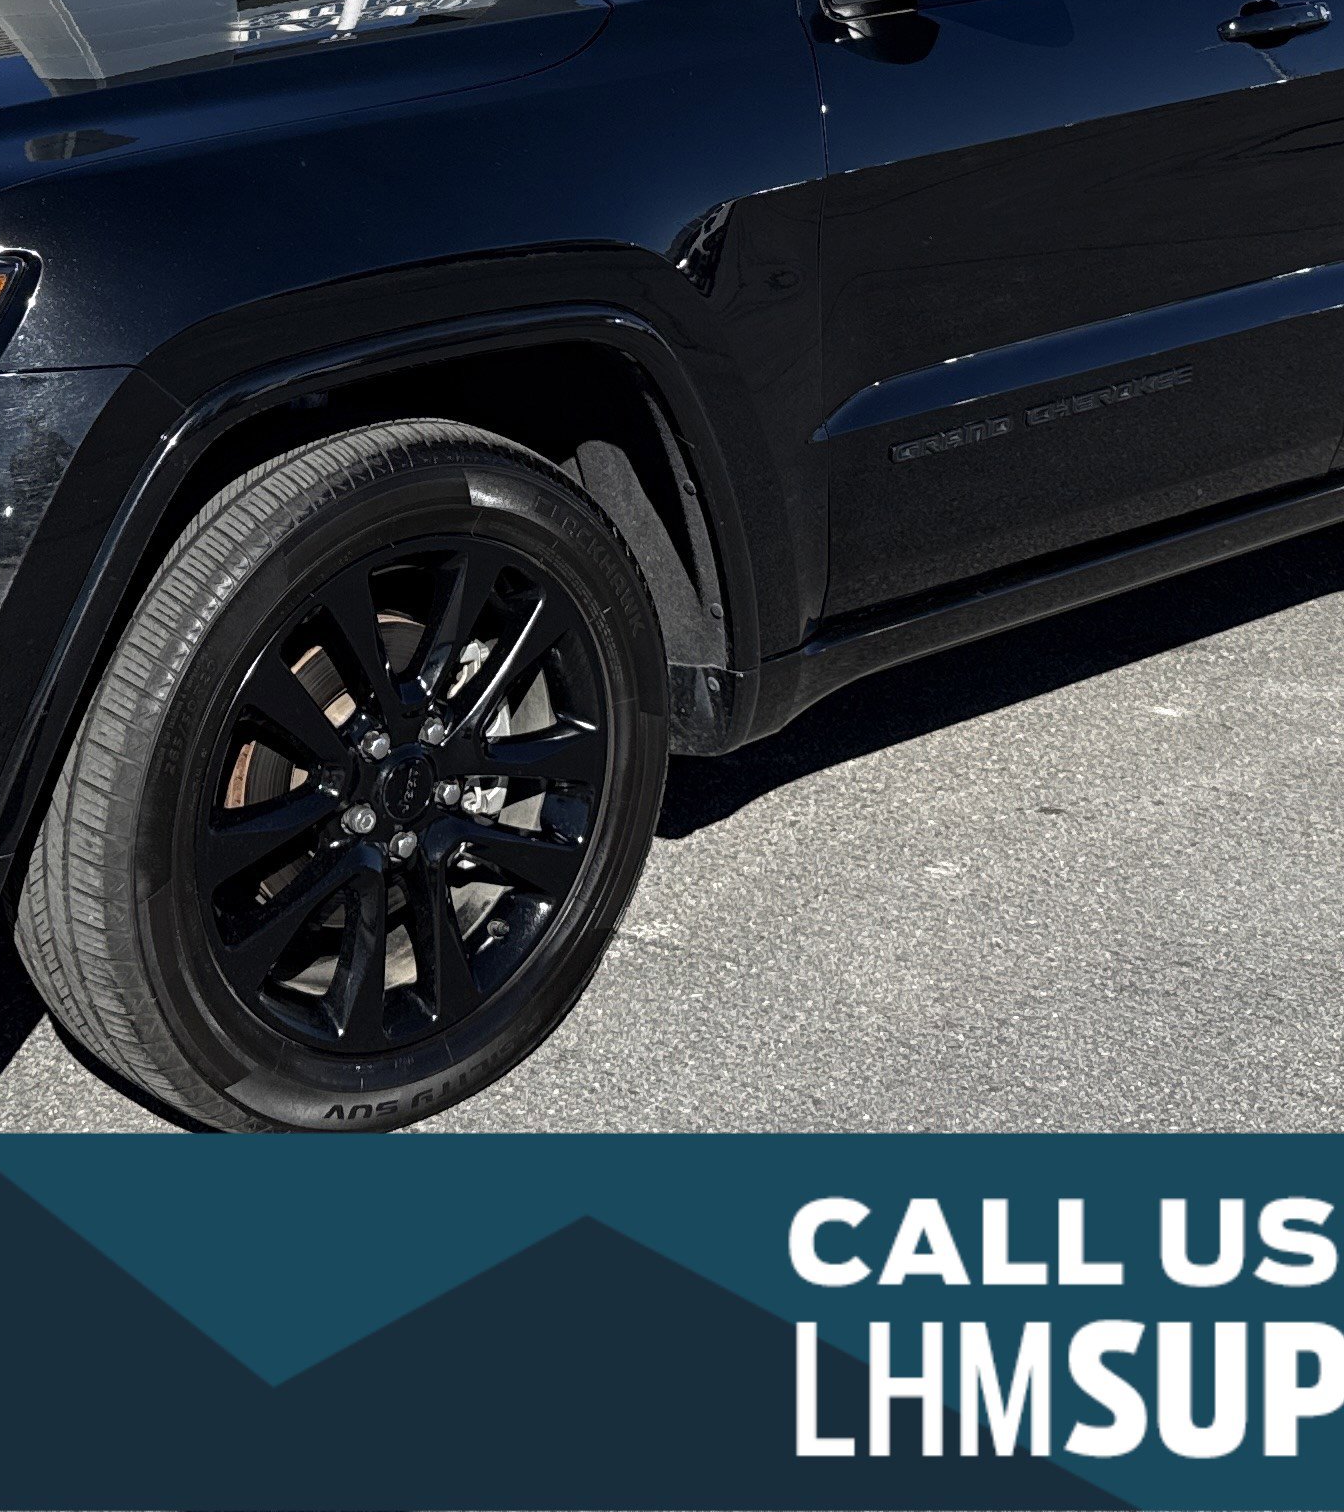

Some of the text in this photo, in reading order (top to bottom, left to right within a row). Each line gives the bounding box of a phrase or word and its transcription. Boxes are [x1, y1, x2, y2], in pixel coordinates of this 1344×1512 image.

[888, 363, 1194, 464] GRAND CHEROKEE
[322, 1099, 399, 1120] SUV
